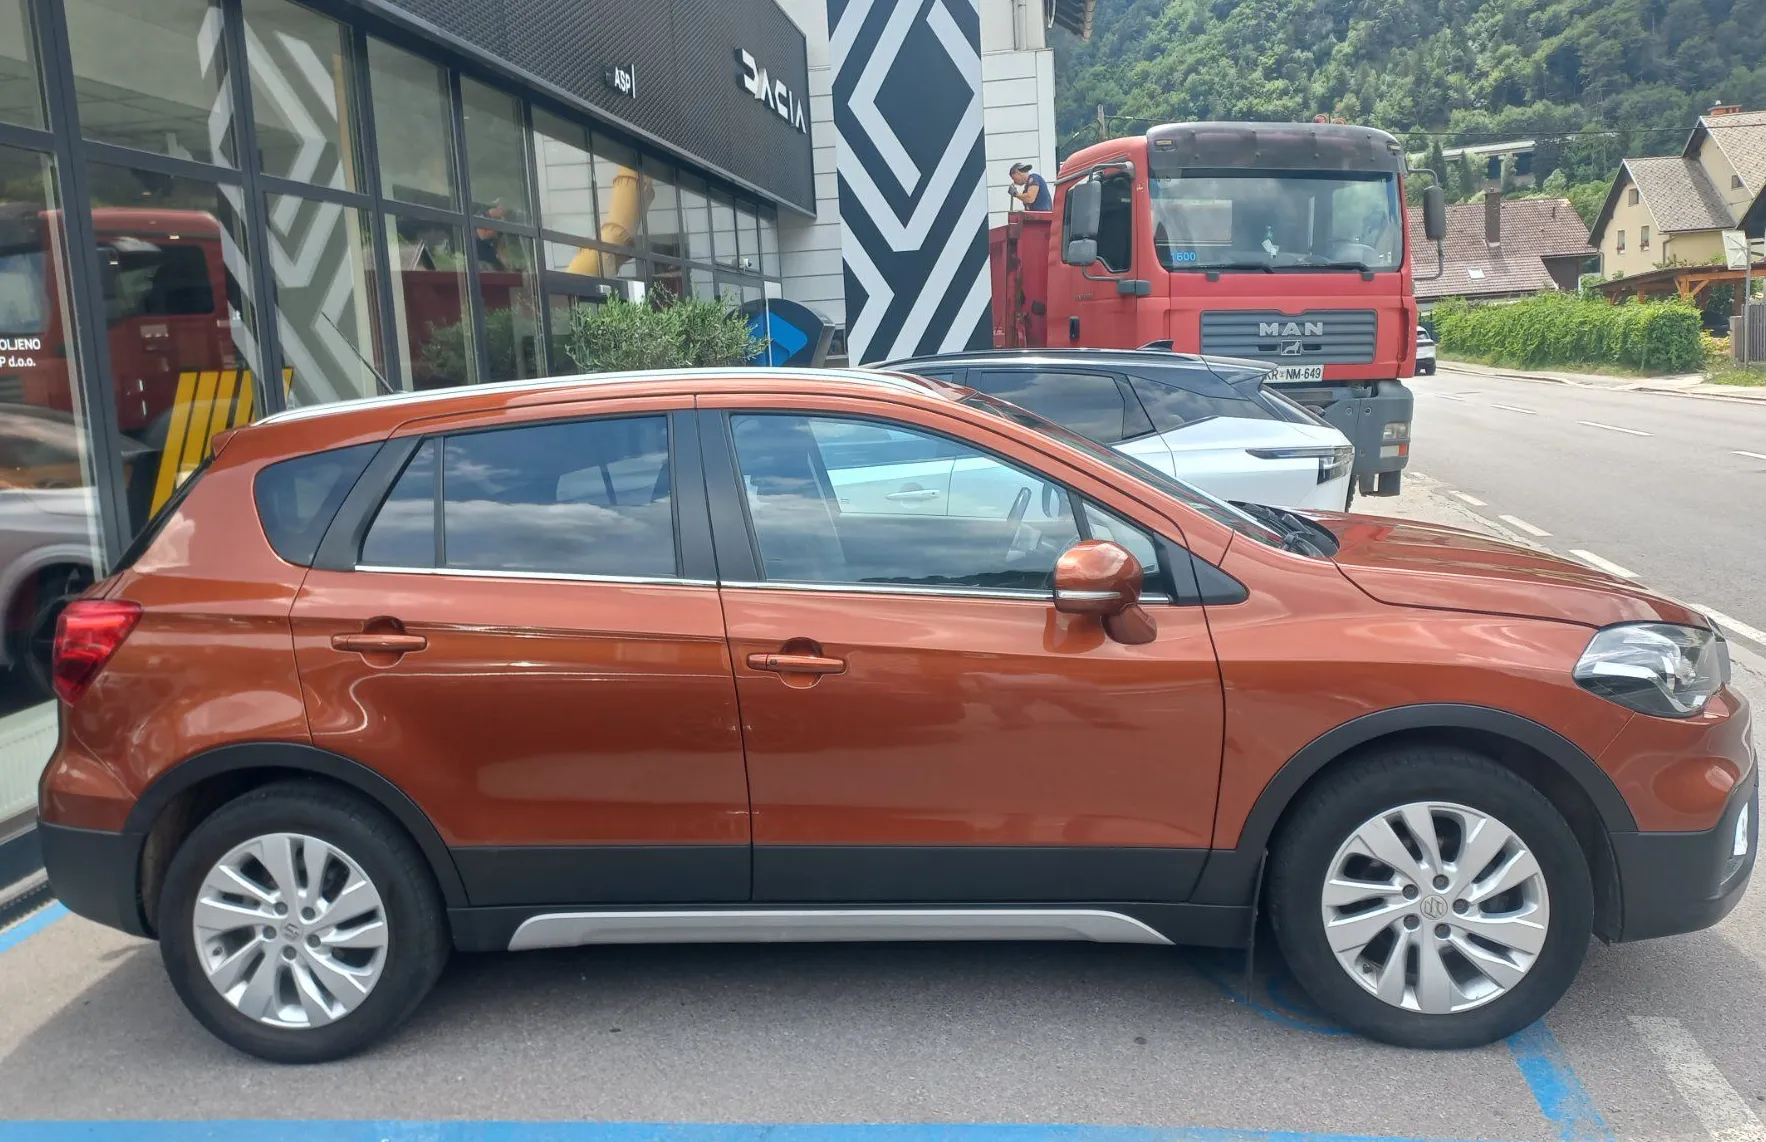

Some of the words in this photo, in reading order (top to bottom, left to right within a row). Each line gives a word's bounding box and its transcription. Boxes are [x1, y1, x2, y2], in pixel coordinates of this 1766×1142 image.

[614, 66, 631, 94] ASP
[736, 48, 807, 134] DACIA
[1259, 321, 1324, 337] MAN
[8, 354, 37, 368] d.o.o.
[1285, 367, 1322, 380] NM-649
